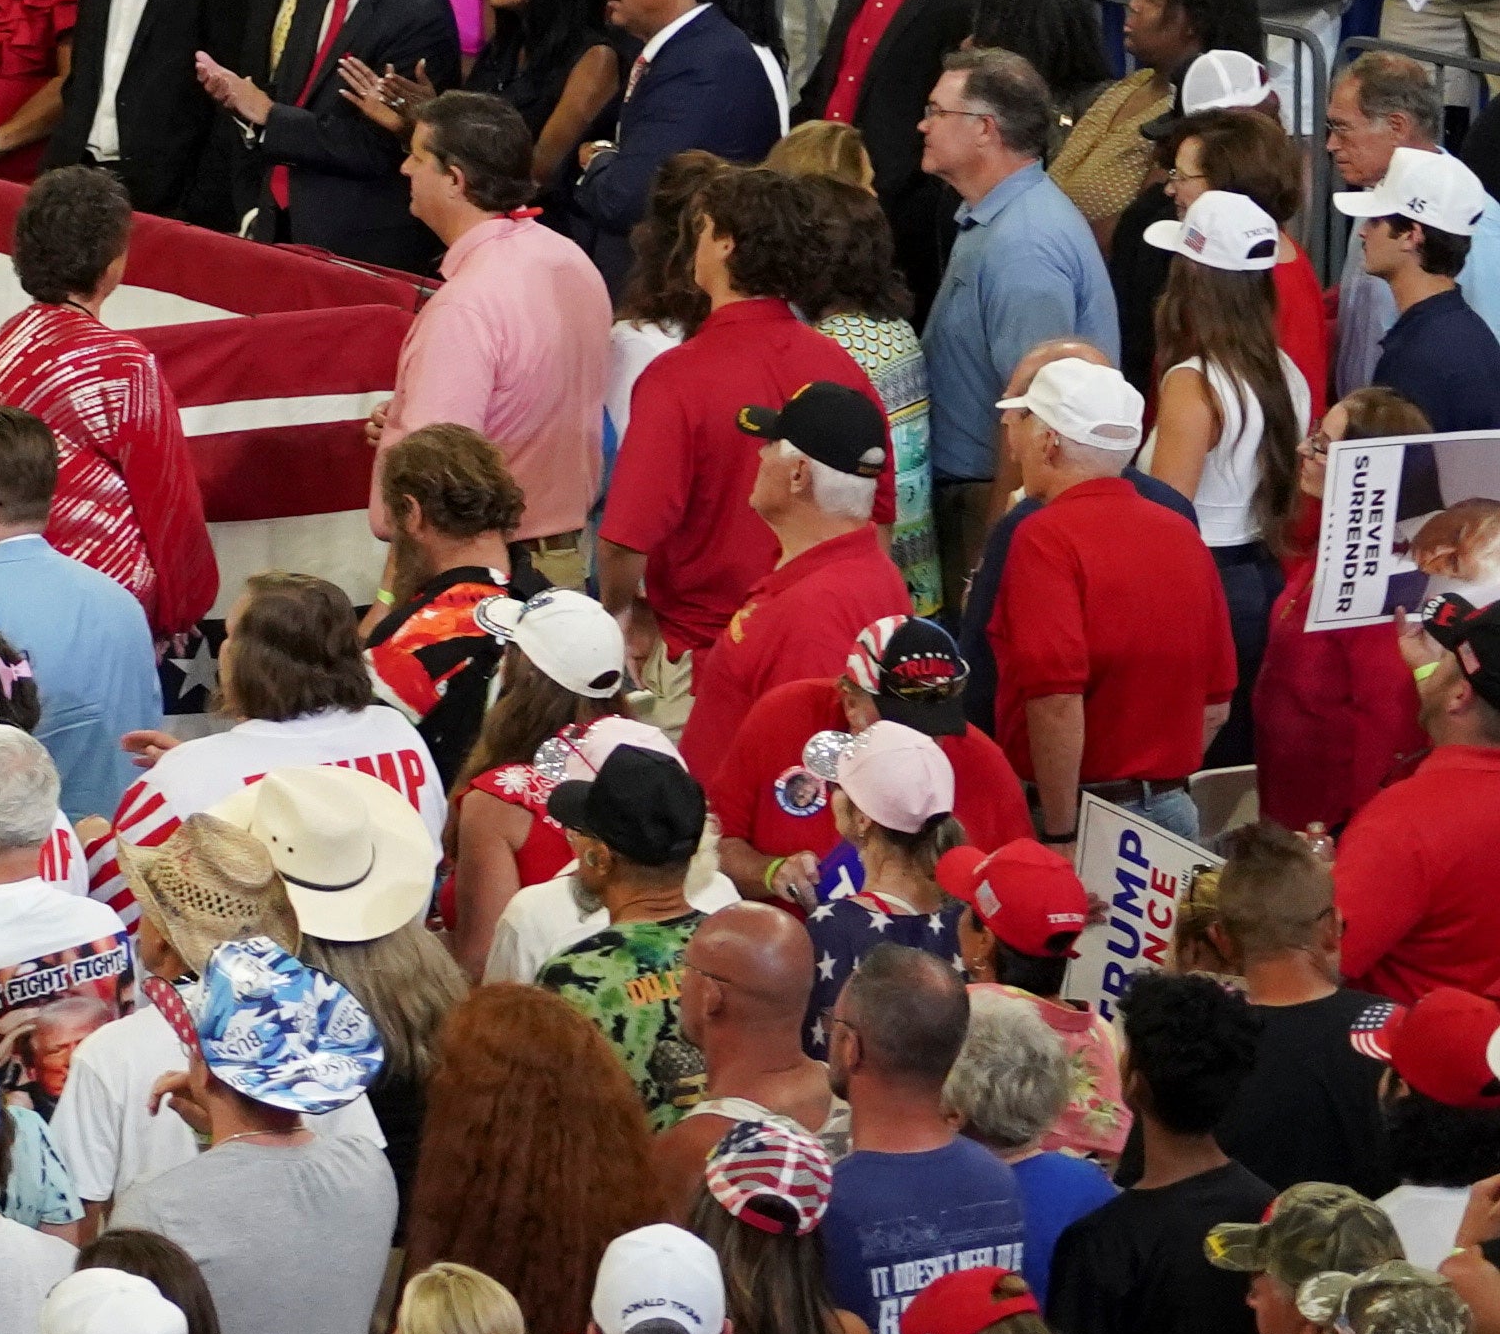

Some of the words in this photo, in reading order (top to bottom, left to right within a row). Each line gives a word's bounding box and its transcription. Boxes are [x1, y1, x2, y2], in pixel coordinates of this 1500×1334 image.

[1406, 197, 1428, 214] 45
[1336, 454, 1370, 614] SURRENDER
[1365, 488, 1388, 578] NEVER
[1047, 913, 1084, 923] TRUMP
[1143, 866, 1178, 966] NCE
[7, 968, 67, 1004] FIGHT
[871, 1268, 890, 1297] IT
[621, 1298, 667, 1320] DONALD
